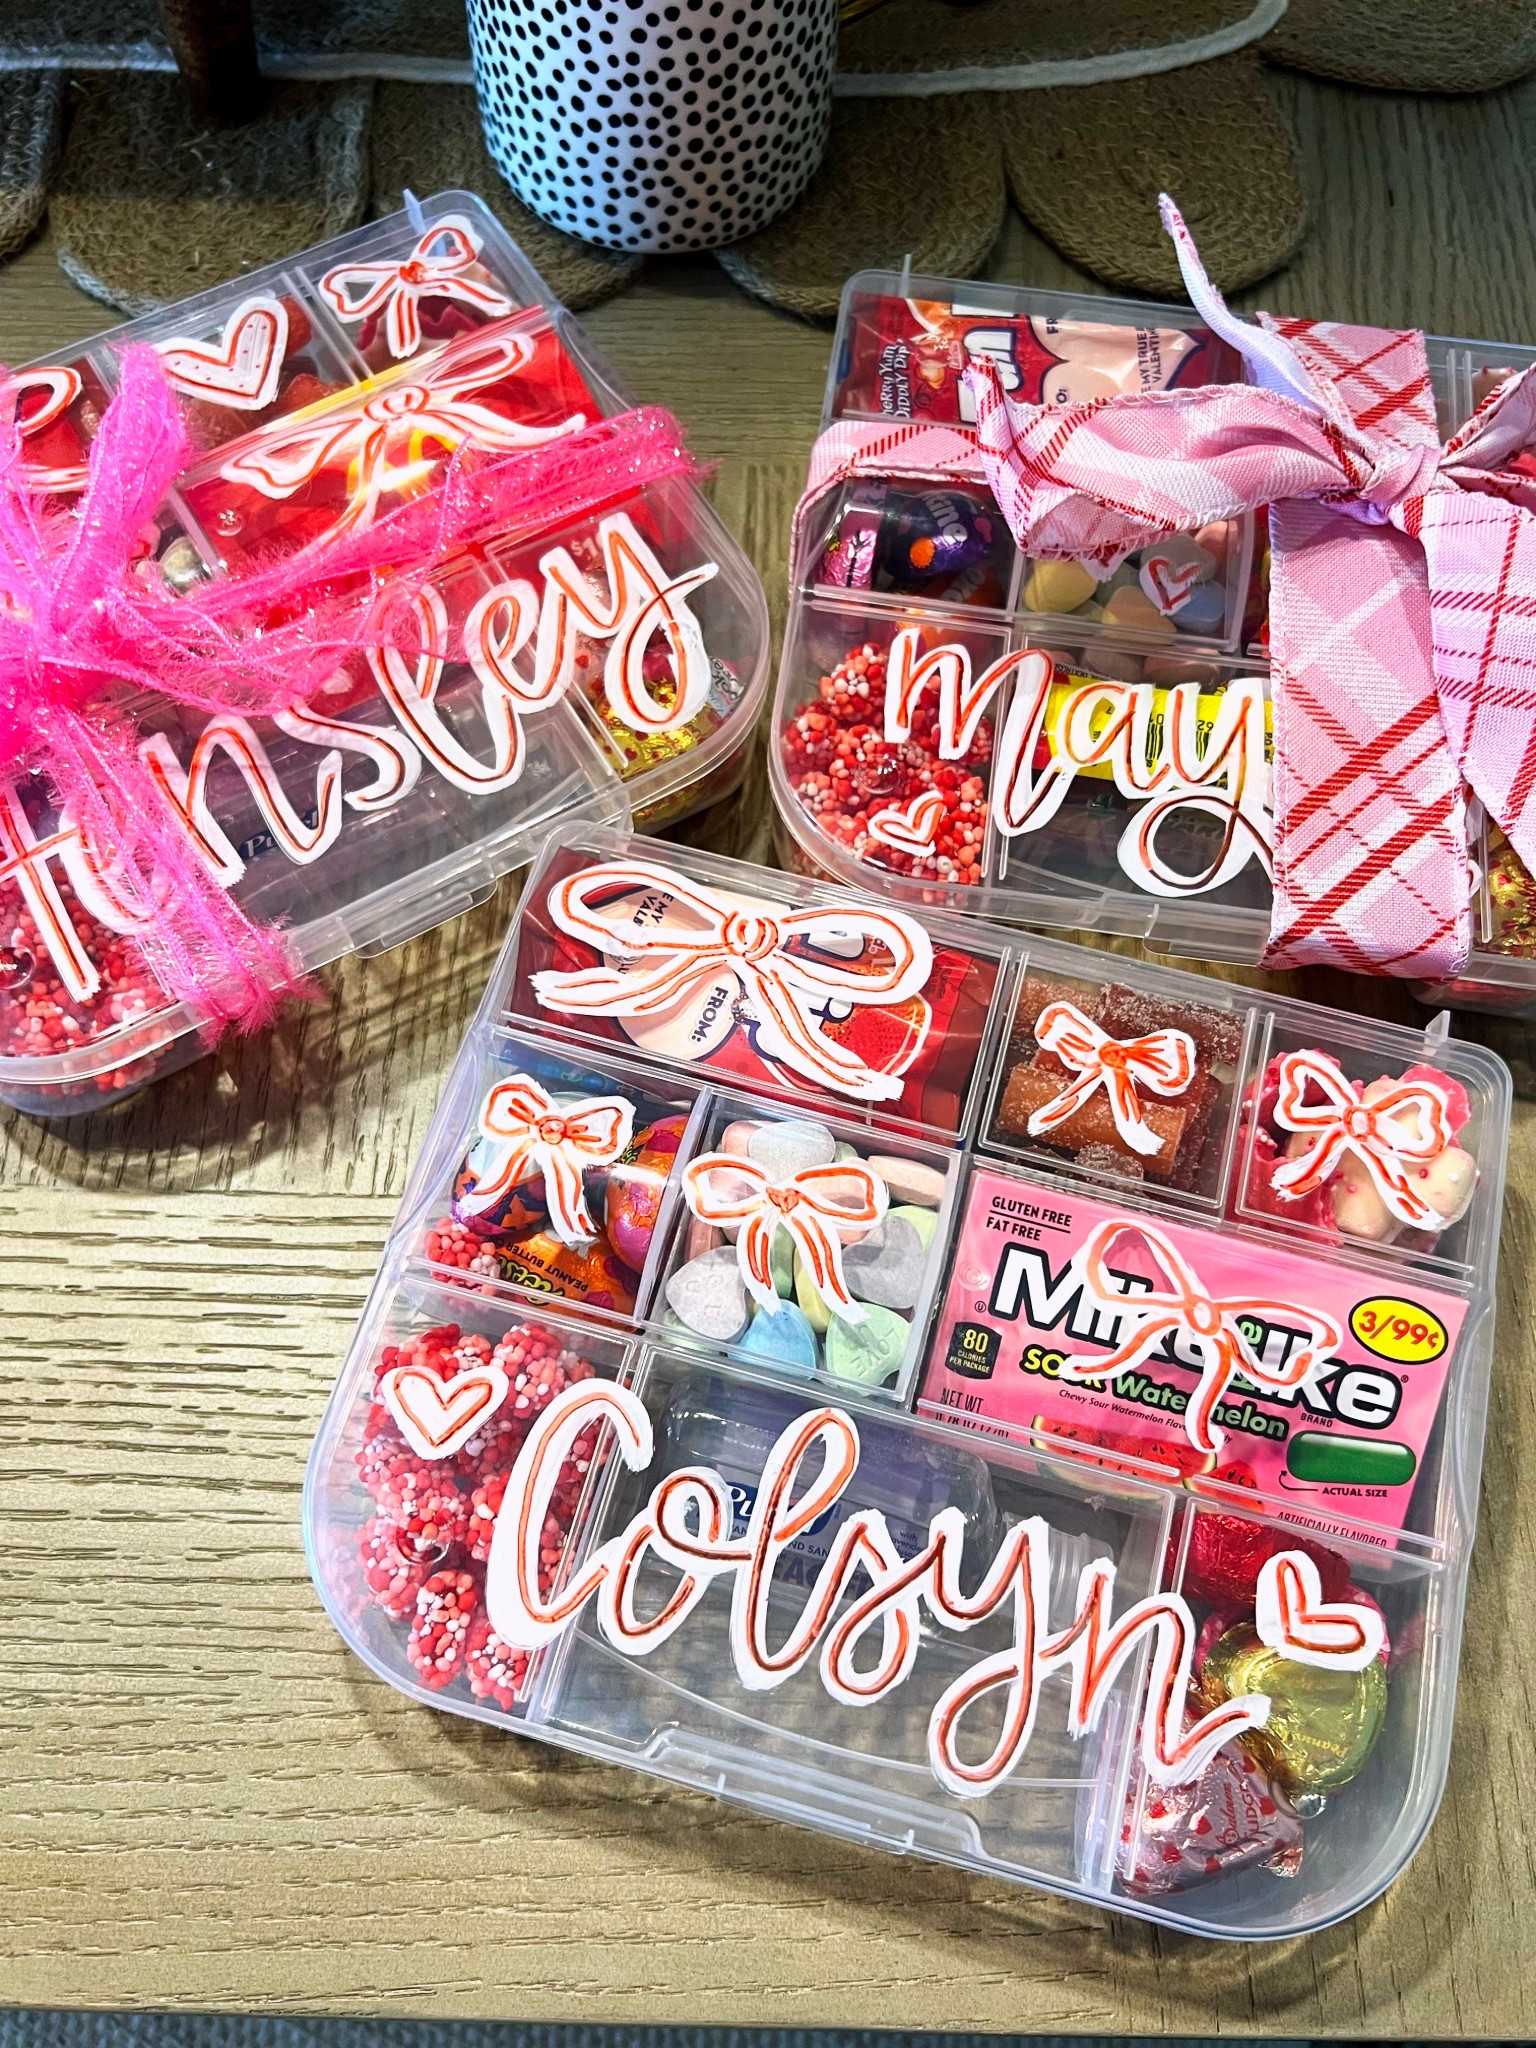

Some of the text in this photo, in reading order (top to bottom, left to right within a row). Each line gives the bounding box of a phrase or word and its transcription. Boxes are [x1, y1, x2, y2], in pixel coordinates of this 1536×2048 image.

[1137, 332, 1149, 367] TRUE
[691, 986, 728, 1042] FROM:
[992, 1196, 1073, 1227] GLUTEN FREE
[986, 1216, 1042, 1241] FAT FREE
[506, 1241, 545, 1267] BUTTER
[544, 1263, 589, 1292] PEANUT
[963, 1329, 990, 1353] 80
[1358, 1311, 1440, 1349] 3/99¢
[949, 1355, 990, 1374] PER PACKAGE
[957, 1350, 986, 1364] CALORIES
[1059, 1388, 1087, 1405] Chewy
[1089, 1396, 1110, 1409] Sour
[1111, 1403, 1164, 1424] Watermelon
[1300, 1412, 1333, 1428] BRAND
[1322, 1487, 1388, 1498] ACTUAL SIZE
[487, 1379, 1270, 1798] Colsyn
